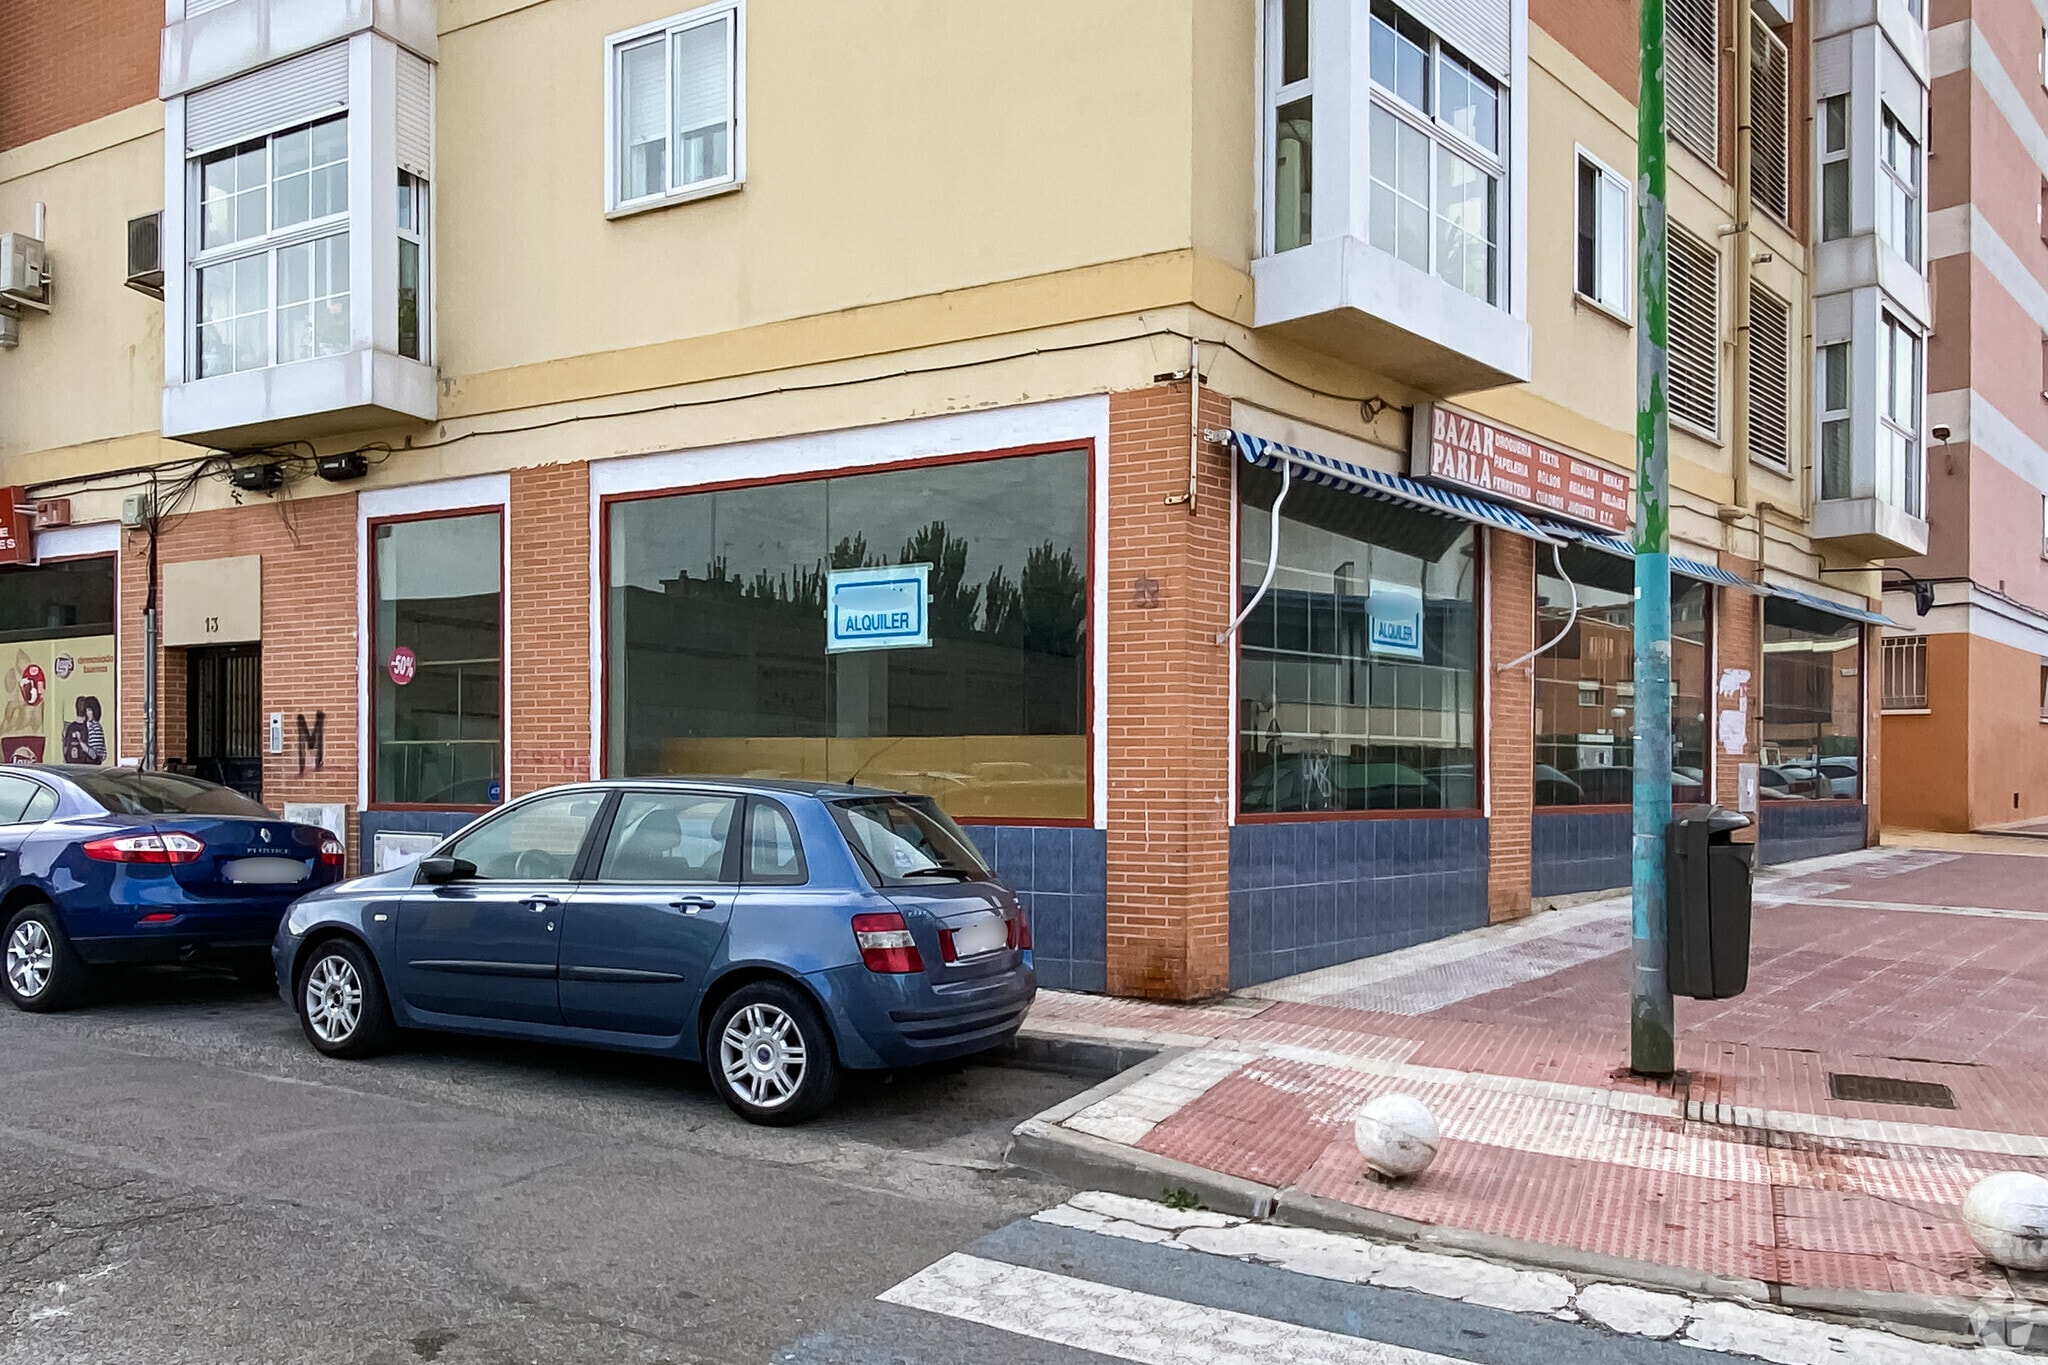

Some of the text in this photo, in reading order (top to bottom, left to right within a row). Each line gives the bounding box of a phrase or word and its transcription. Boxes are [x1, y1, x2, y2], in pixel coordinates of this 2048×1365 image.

[1433, 408, 1494, 458] BAZAR
[1432, 442, 1491, 489] PARLA
[1494, 455, 1626, 511] PAPELERIA BOLSOS REGALOS RELOJES
[1539, 449, 1560, 469] TEXTIL
[1602, 472, 1624, 491] MENAJE
[1493, 476, 1532, 499] FERRETERIA
[1536, 490, 1564, 510] CUADROS
[1568, 501, 1596, 520] JUGUETES
[205, 616, 219, 633] 13
[846, 612, 909, 632] ALQUILER
[1378, 621, 1413, 641] ALQUILER
[390, 654, 414, 678] -50%
